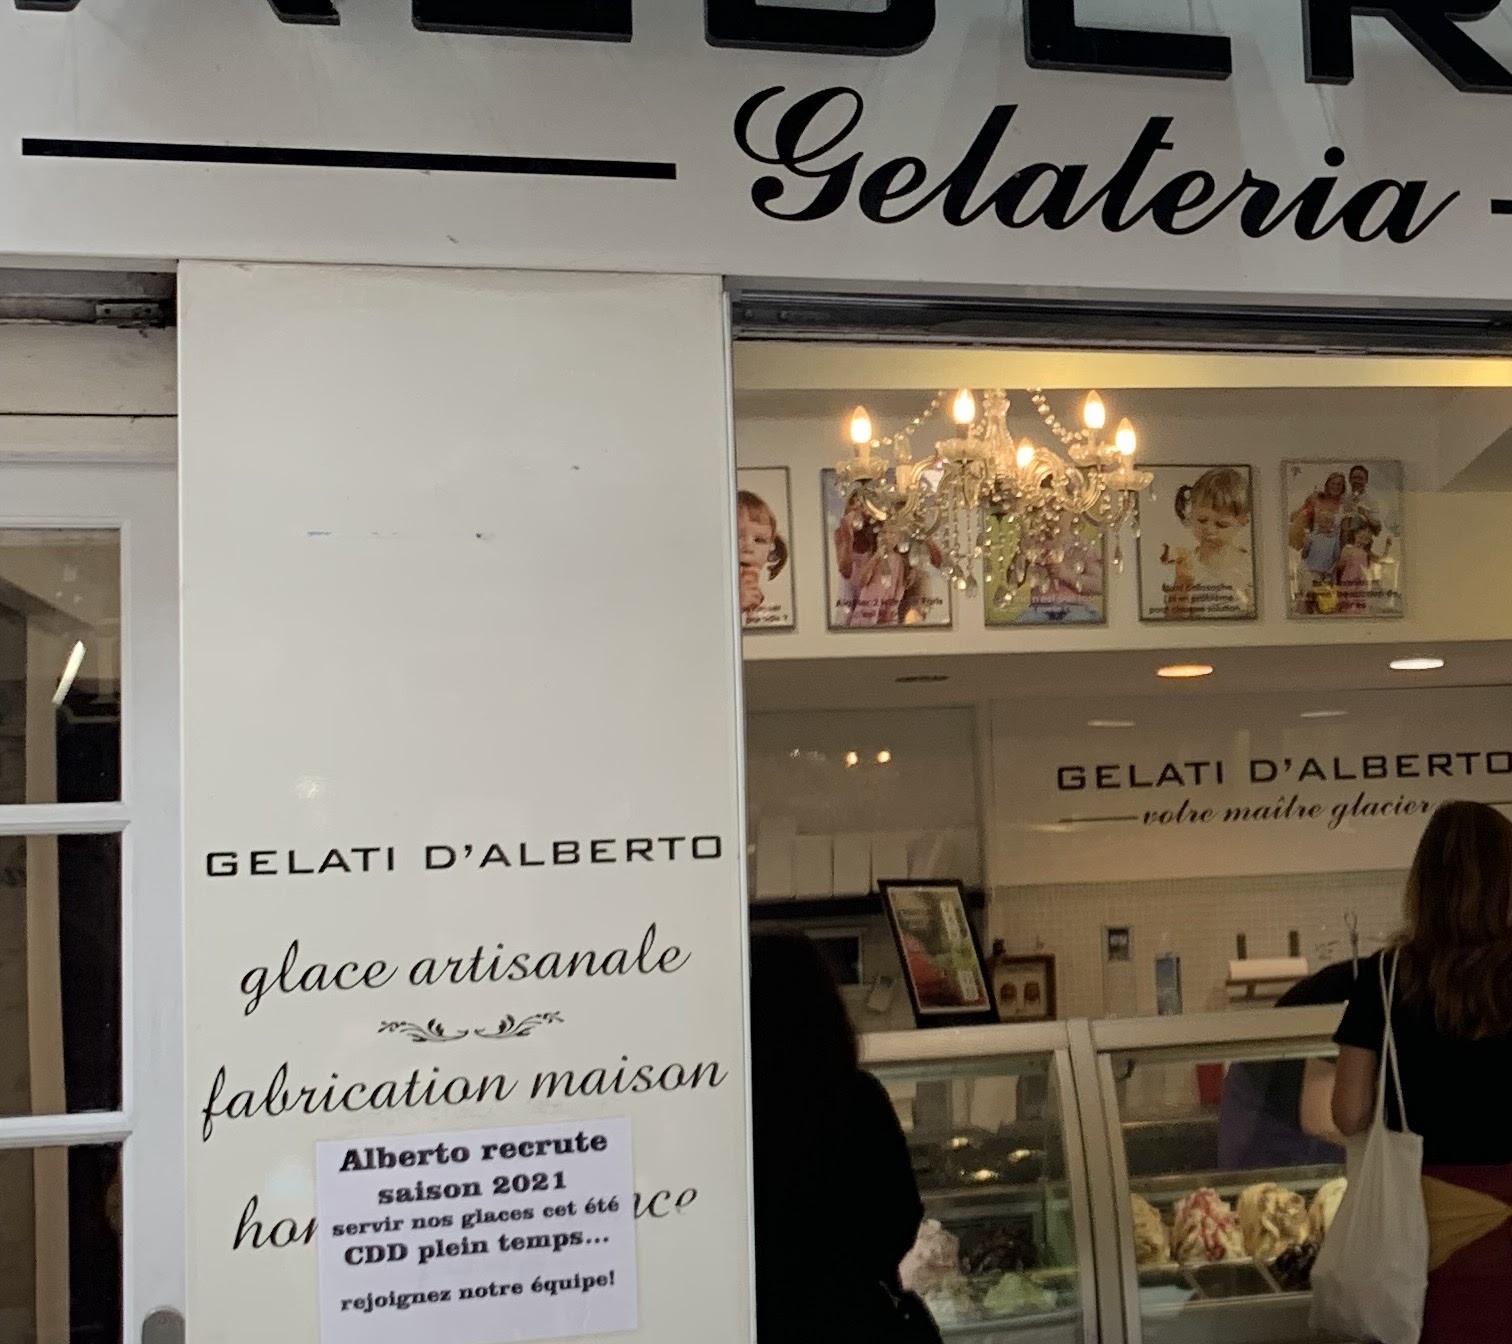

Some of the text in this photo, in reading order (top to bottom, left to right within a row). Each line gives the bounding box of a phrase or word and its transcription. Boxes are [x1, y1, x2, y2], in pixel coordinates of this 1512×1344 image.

[731, 85, 1462, 246] Gelateria
[1057, 760, 1224, 791] GELATI
[1143, 791, 1436, 830] votre maître glacier
[205, 834, 724, 878] GELATI D'ALBERTO
[239, 922, 693, 1017] glace artisanale
[202, 1055, 729, 1143] fabrication maison
[339, 1131, 608, 1173] Alberto recrute
[378, 1170, 567, 1206] saison 2021
[332, 1195, 620, 1237] servir nos glaces cet été
[343, 1229, 610, 1267] CDD plein temps...
[340, 1269, 617, 1314] rejoignez notre équipe!
